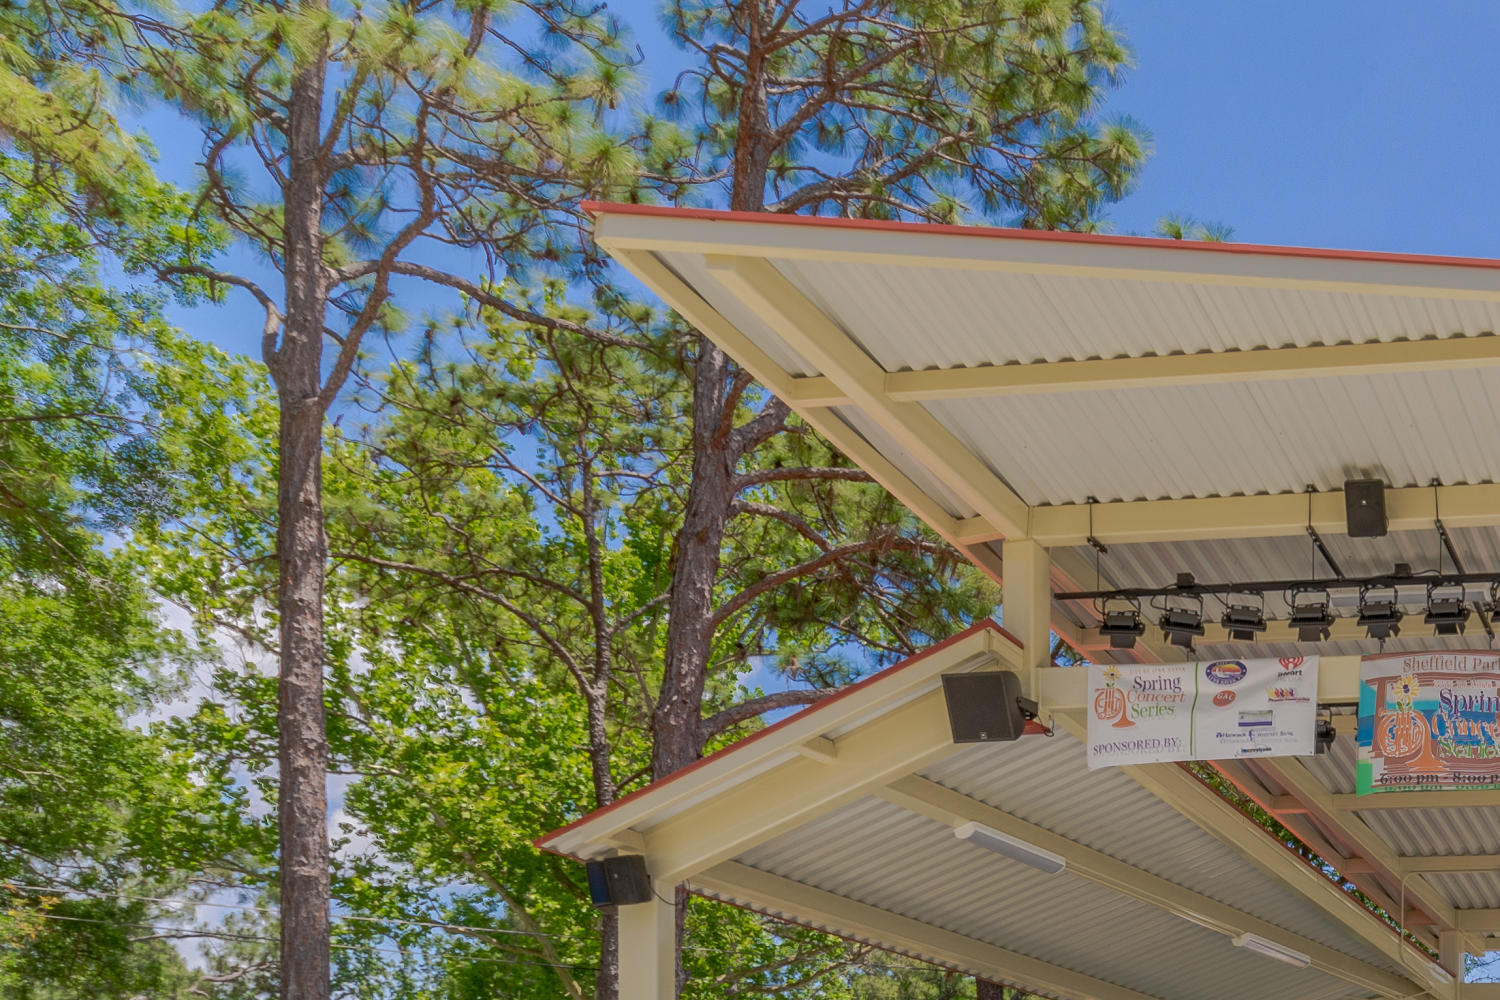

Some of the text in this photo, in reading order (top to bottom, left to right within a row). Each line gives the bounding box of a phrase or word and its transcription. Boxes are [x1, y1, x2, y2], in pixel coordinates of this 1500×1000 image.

[1402, 655, 1468, 672] Sheffield
[1133, 675, 1182, 694] Spring
[1127, 689, 1185, 704] Concert
[1131, 703, 1176, 718] Series
[1093, 736, 1182, 755] SPONSORED BY:
[1380, 773, 1412, 785] 6:00
[1416, 773, 1439, 785] pm
[1453, 771, 1486, 783] 8:00
